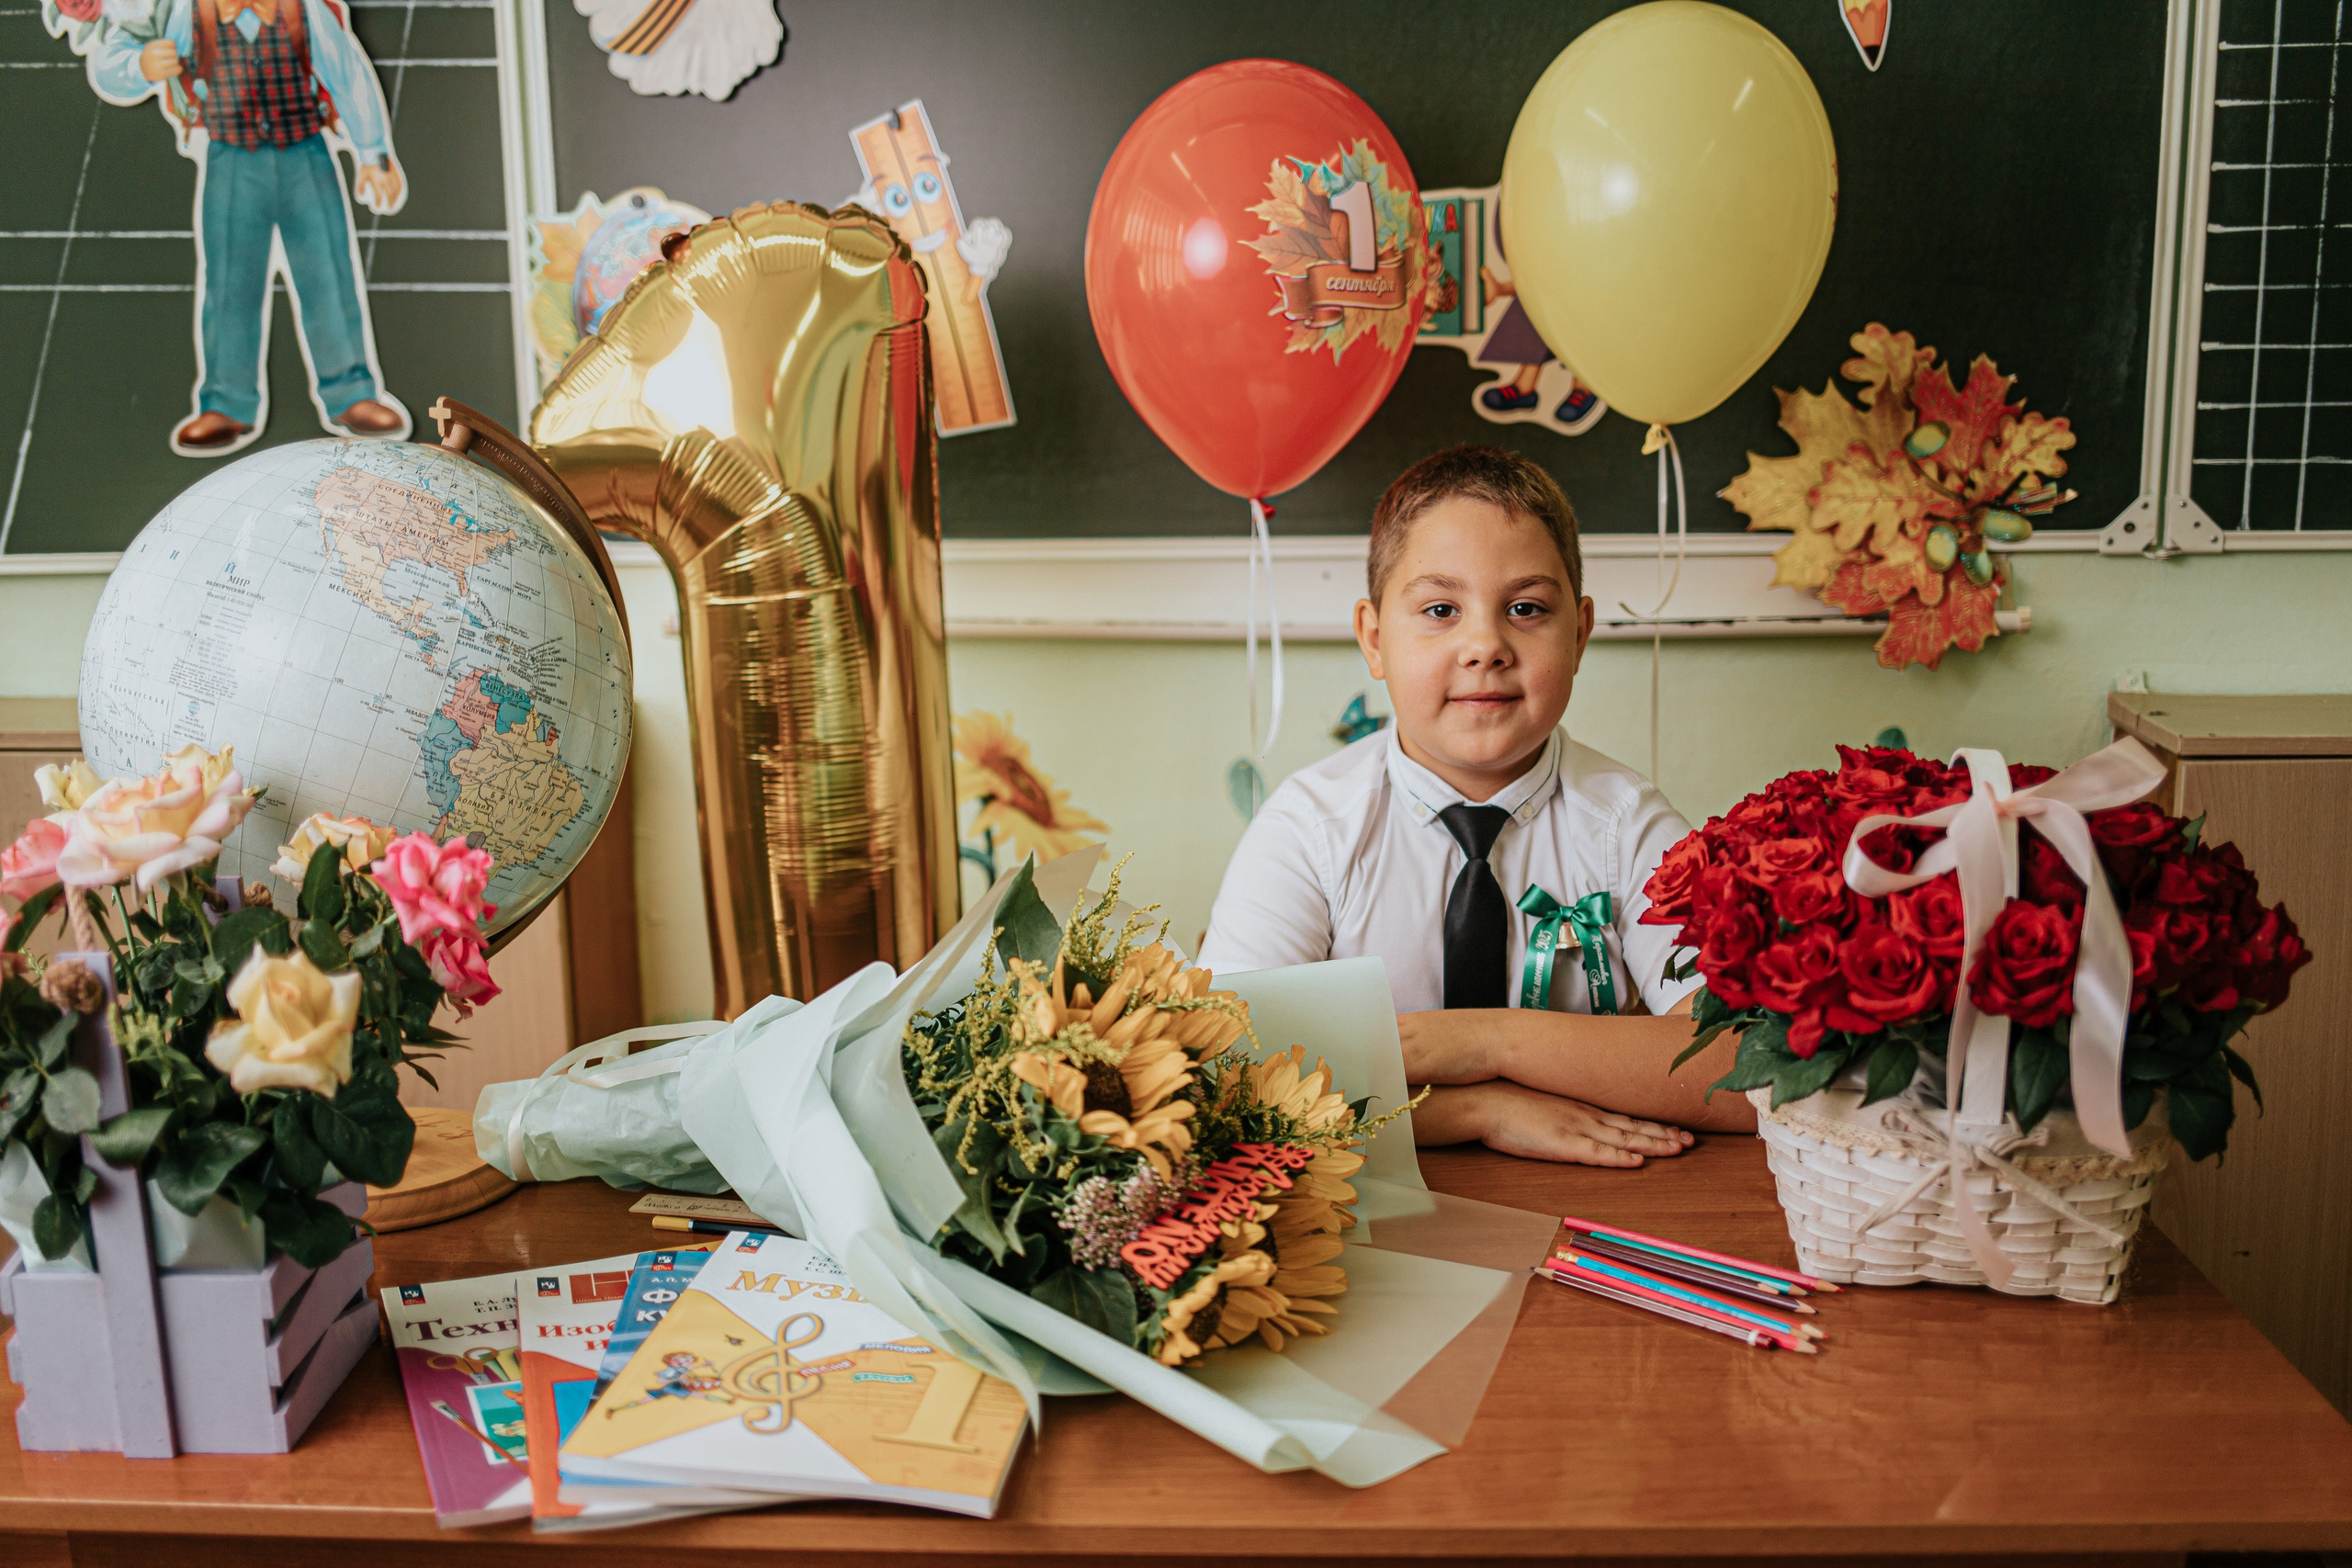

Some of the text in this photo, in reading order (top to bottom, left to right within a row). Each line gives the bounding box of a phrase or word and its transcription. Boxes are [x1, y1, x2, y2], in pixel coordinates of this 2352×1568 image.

[1329, 180, 1378, 274] 1
[1326, 276, 1395, 298] сентября
[356, 511, 449, 547] ШТАТЫ АМЕРИКИ
[227, 575, 250, 587] МИР
[404, 567, 449, 588] Мексиканский
[412, 580, 429, 589] залив
[477, 575, 514, 593] САРГАССОВО
[516, 591, 532, 601] МОРЕ
[205, 580, 266, 602] политический глобус
[328, 583, 370, 602] МЕКСИКА
[456, 638, 492, 656] КАРИБСКОЕ
[495, 652, 511, 662] МОРЕ
[334, 676, 344, 684] 100
[485, 682, 524, 701] ВЕНЕСУЭЛА
[404, 707, 429, 719] ЭКВАДОР
[462, 705, 495, 720] КОЛУМБИЯ
[432, 771, 458, 783] ПЕРУ
[458, 796, 490, 812] БОЛИВИЯ
[490, 791, 554, 819] БРАЗИЛИЯ
[405, 1318, 517, 1341] Техн
[872, 1360, 984, 1454] 1
